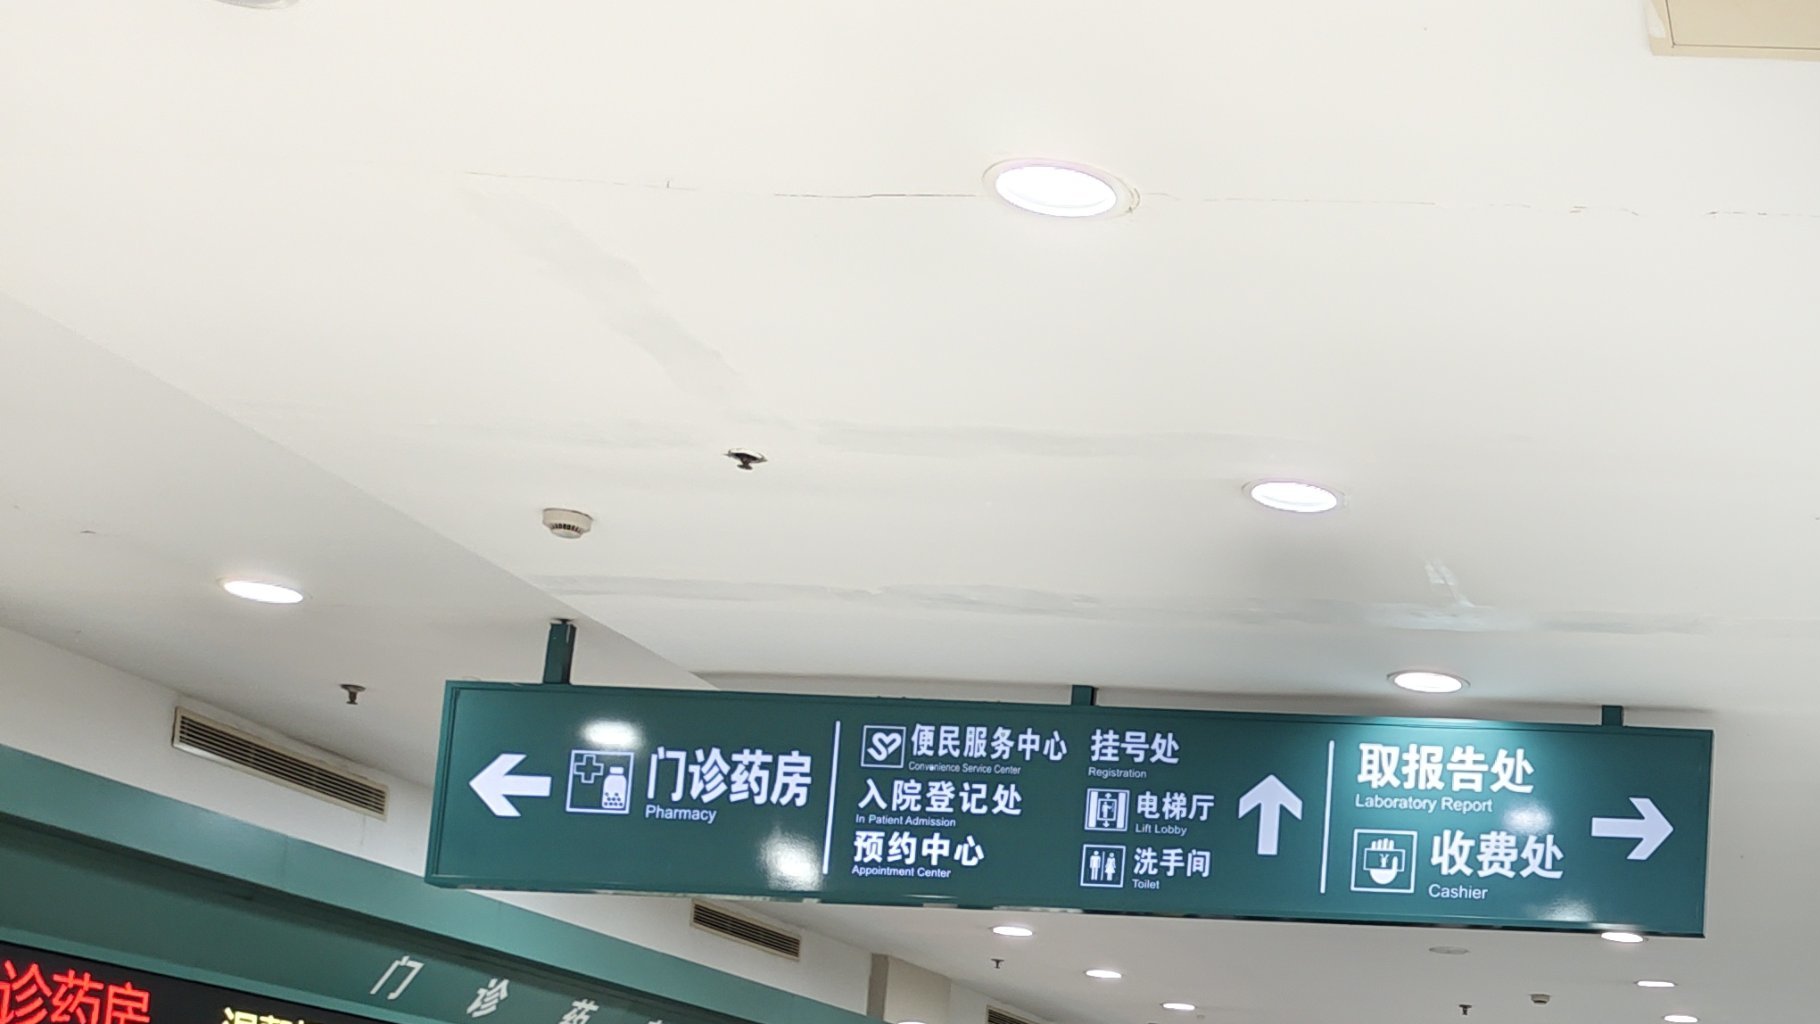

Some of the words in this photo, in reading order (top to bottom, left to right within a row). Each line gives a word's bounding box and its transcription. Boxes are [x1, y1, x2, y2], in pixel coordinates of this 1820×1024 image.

[910, 723, 1068, 763] 便民服务中心
[1089, 728, 1180, 765] 挂号处
[645, 746, 813, 808] 门诊药房
[908, 761, 960, 773] Convenience
[962, 763, 992, 774] Service
[994, 765, 1021, 775] Center
[1088, 766, 1147, 779] Registration
[1356, 743, 1535, 796] 取报告处
[856, 779, 1023, 817] 入院登记处
[1135, 791, 1215, 823] 电梯厅
[1355, 794, 1436, 814] Laboratory
[1440, 797, 1493, 815] Report
[645, 804, 717, 825] Pharmacy
[855, 814, 865, 823] In
[868, 814, 903, 825] Patient
[904, 815, 957, 827] Admission
[1135, 823, 1152, 834] Lift
[1154, 825, 1188, 838] Lobby
[853, 832, 984, 867] 预约中心
[1431, 829, 1564, 881] 收费处
[851, 865, 914, 877] Appointment
[917, 867, 952, 878] Center
[1133, 848, 1211, 878] 洗手间
[1132, 879, 1161, 890] Toilet
[1428, 883, 1489, 901] Cashier
